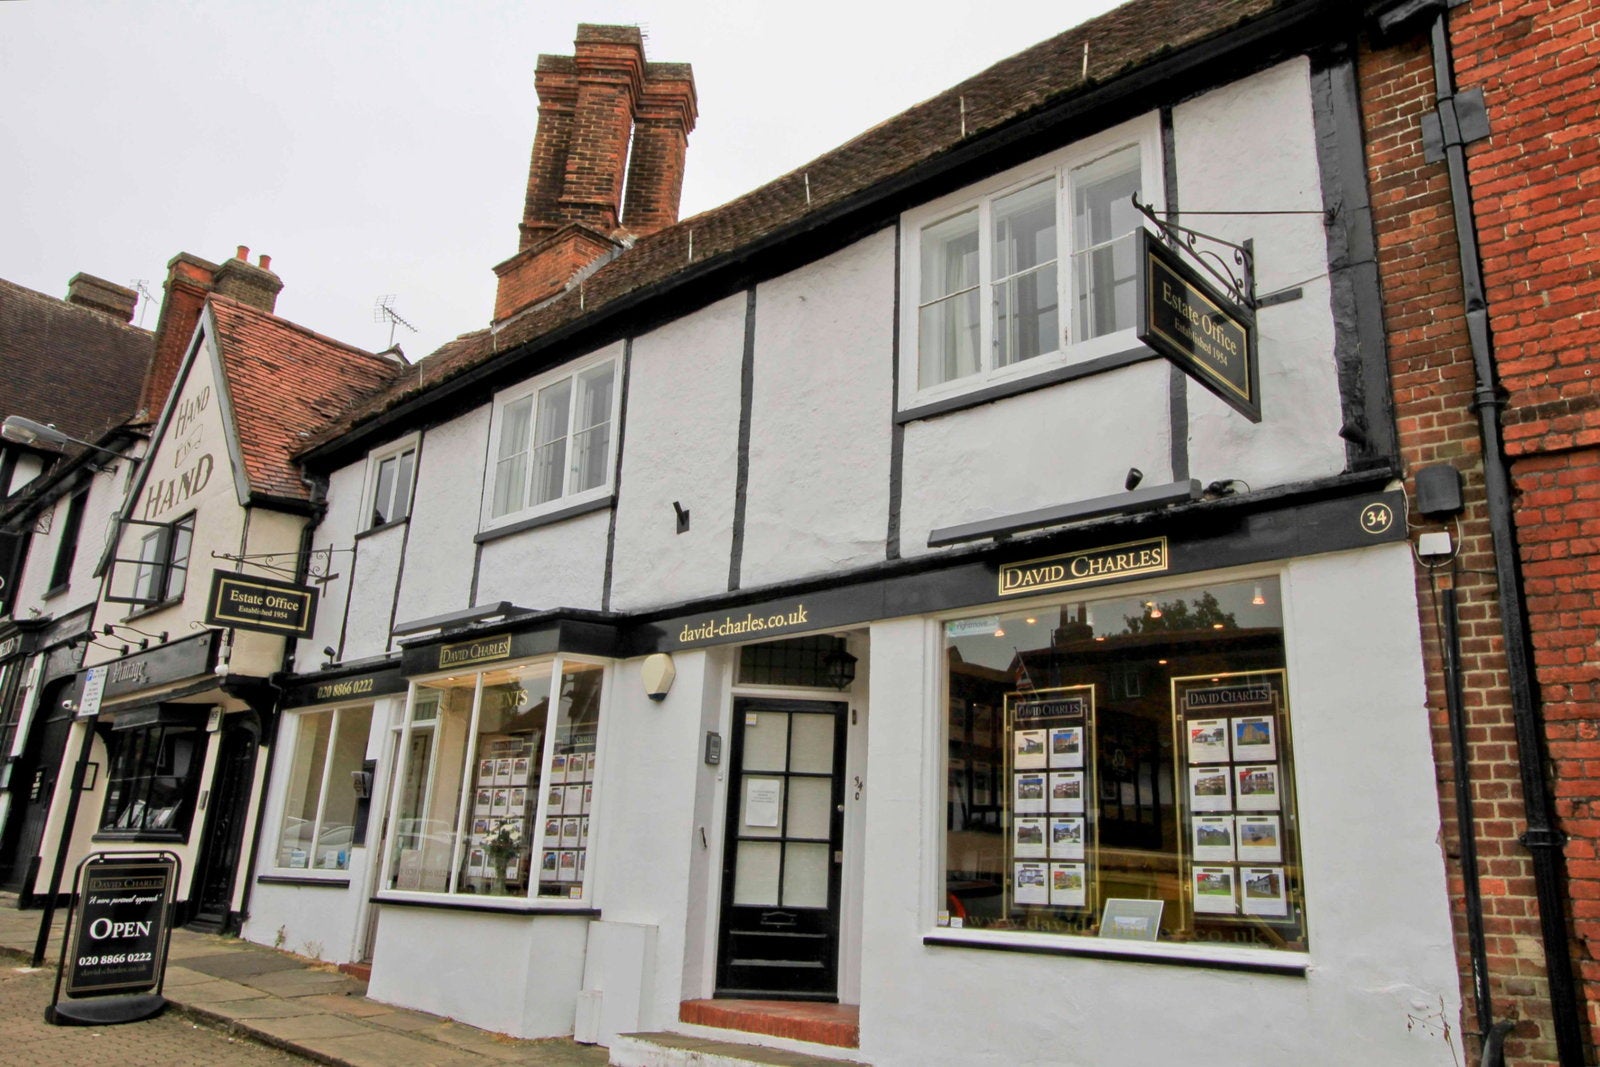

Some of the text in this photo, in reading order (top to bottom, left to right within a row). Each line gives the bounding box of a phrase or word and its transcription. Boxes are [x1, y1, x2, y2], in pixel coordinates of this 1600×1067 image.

[1162, 280, 1237, 355] Estate Office
[1174, 317, 1228, 367] Established 1954
[174, 385, 210, 440] HAND
[143, 453, 214, 521] HAND
[1366, 509, 1387, 527] 34
[1004, 548, 1161, 589] DAVID CHARLES
[230, 589, 300, 611] Estate Office
[238, 604, 273, 618] Established
[679, 603, 808, 642] david-charles.co.uk
[442, 641, 508, 664] DAVID CHARLES
[317, 679, 374, 699] 020 8866 0222
[1190, 687, 1268, 705] DAVID CHARLES
[1042, 701, 1080, 716] CHARLES
[94, 878, 162, 889] DAVID CHARLES
[89, 917, 153, 940] OPEN
[79, 952, 152, 966] 020 8866 0222
